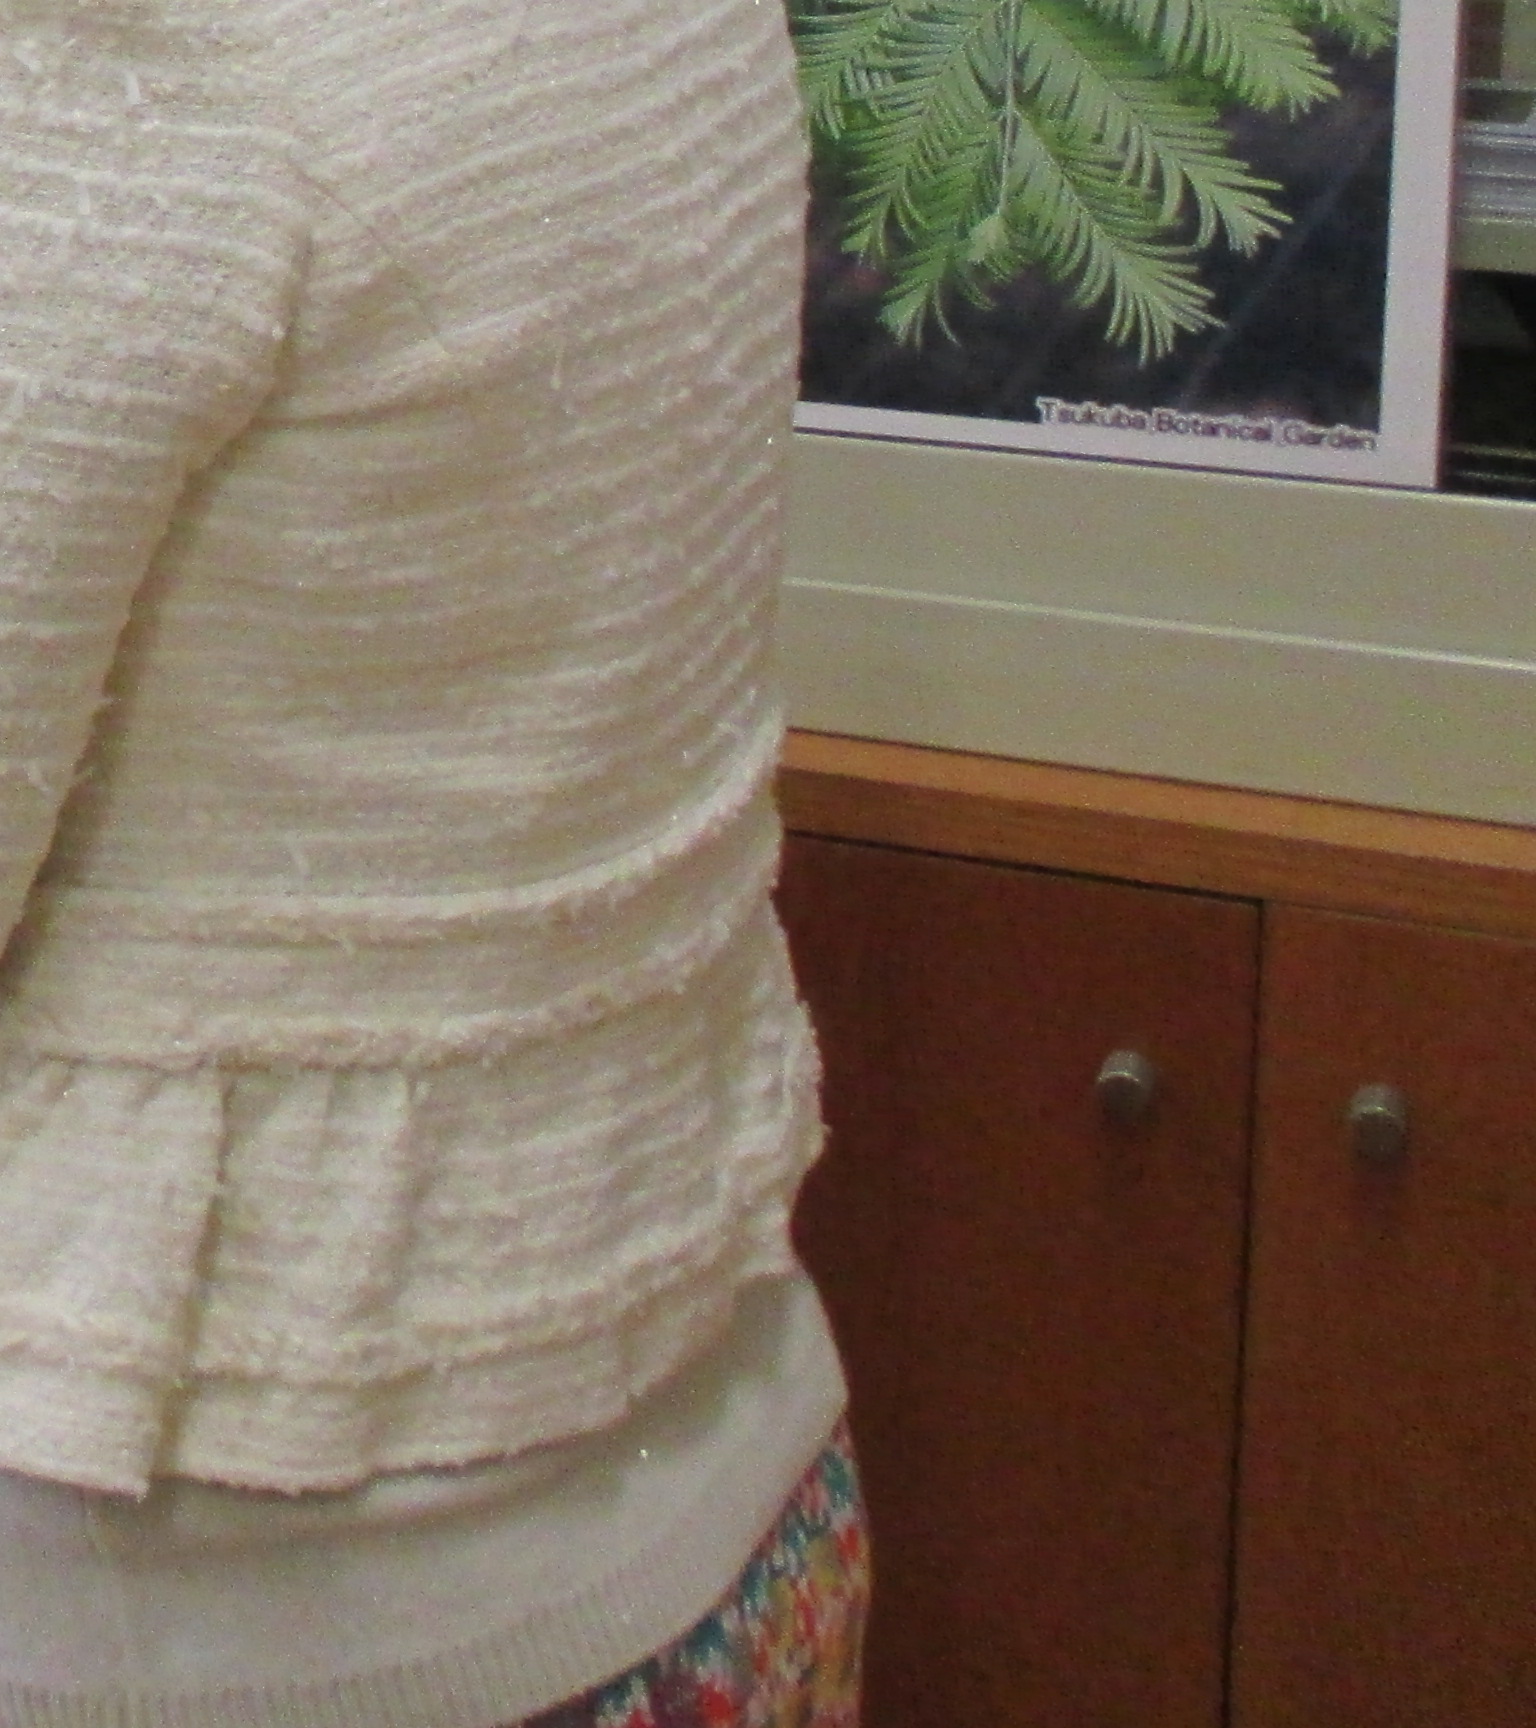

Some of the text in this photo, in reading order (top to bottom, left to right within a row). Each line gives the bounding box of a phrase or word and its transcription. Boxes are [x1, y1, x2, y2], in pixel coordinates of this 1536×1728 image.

[1036, 397, 1377, 452] Tsukuba Botanical Garden
